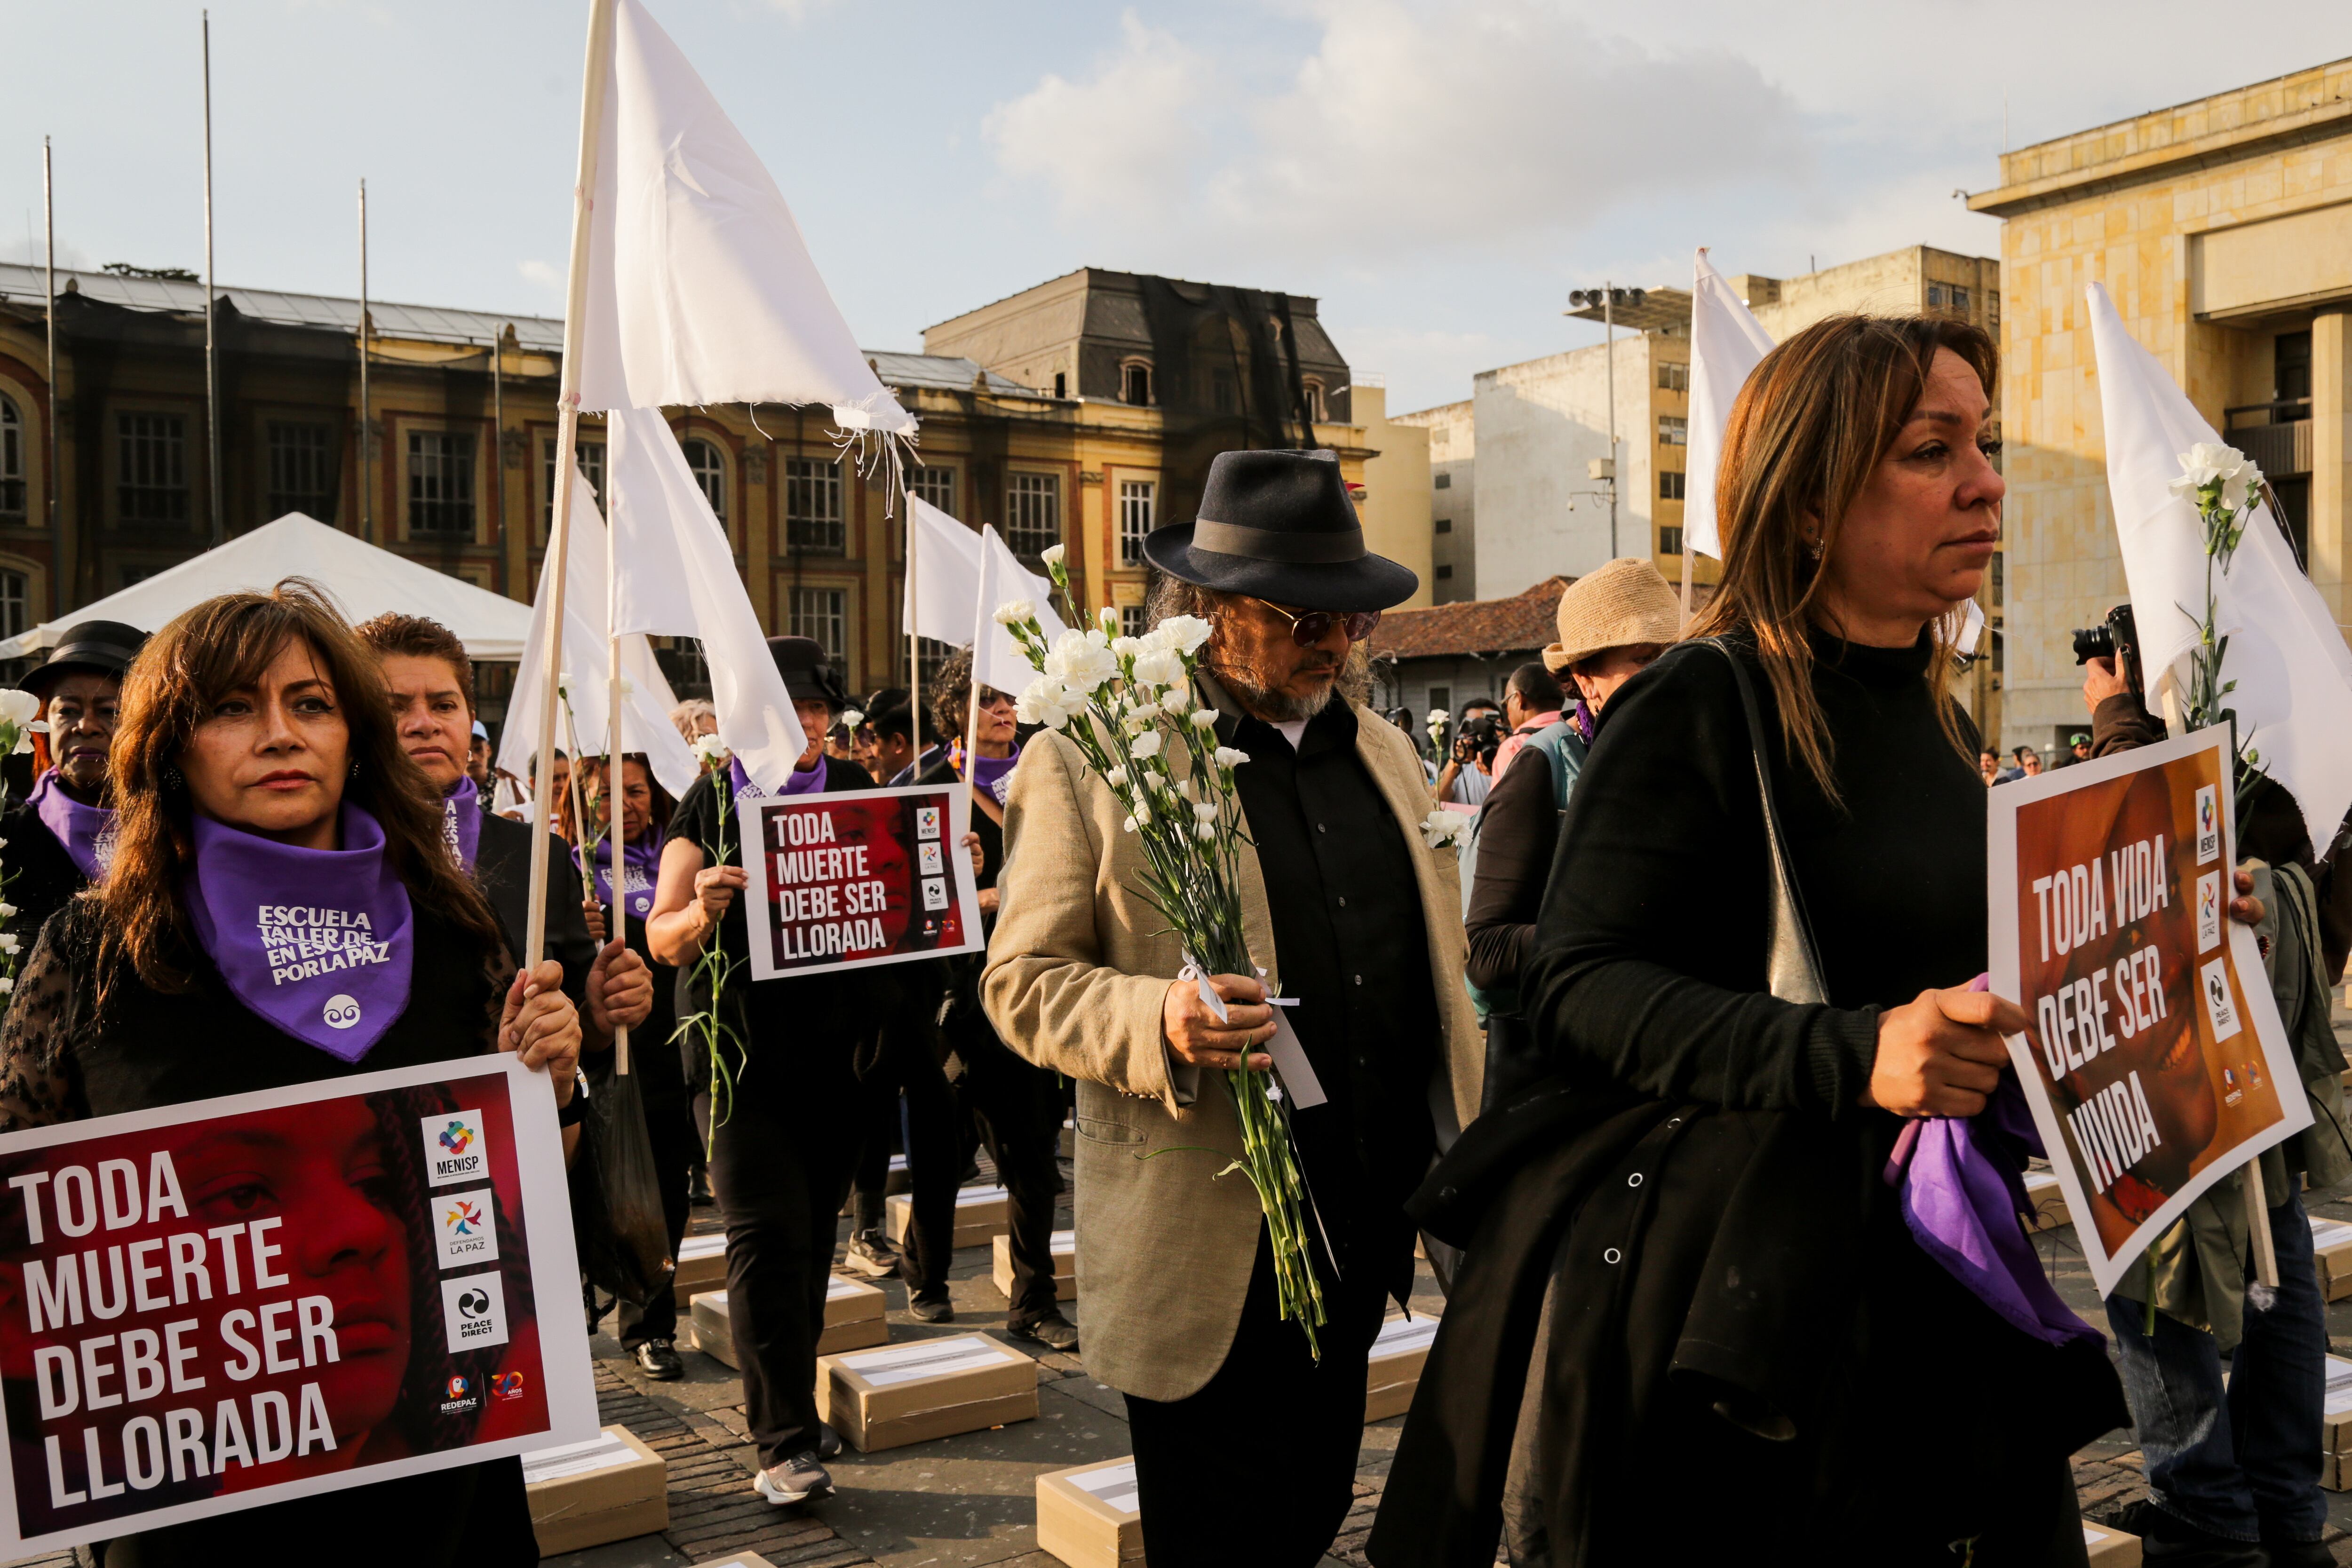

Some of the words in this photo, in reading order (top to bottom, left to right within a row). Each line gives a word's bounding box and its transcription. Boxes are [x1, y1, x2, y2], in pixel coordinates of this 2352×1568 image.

[772, 811, 836, 847] TODA
[777, 845, 870, 885] MUERTE
[259, 905, 372, 930] ESCUELA
[780, 883, 841, 922] DEBE
[844, 880, 887, 915] SER
[2033, 857, 2107, 963] TODA
[2112, 834, 2168, 928] VIDA
[267, 945, 297, 967] EN
[782, 918, 886, 960] LLORADA
[272, 960, 321, 985] POR
[319, 954, 348, 973] LA
[345, 942, 390, 967] PAZ
[2039, 967, 2116, 1081] DEBE
[2115, 944, 2167, 1039] SER
[2067, 1070, 2161, 1195] VIVIDA
[437, 1156, 479, 1175] MENISP
[8, 1150, 189, 1244] TODA
[450, 1236, 484, 1246] DEFENDAMOS
[451, 1246, 463, 1254] LA
[466, 1242, 485, 1252] PAZ
[23, 1216, 289, 1333] MUERTE
[461, 1319, 492, 1330] PEACE
[461, 1327, 493, 1338] DIRECT
[34, 1318, 206, 1420] DEBE
[220, 1295, 340, 1381] SER
[441, 1398, 477, 1411] REDEPAZ
[45, 1382, 337, 1509] LLORADA
